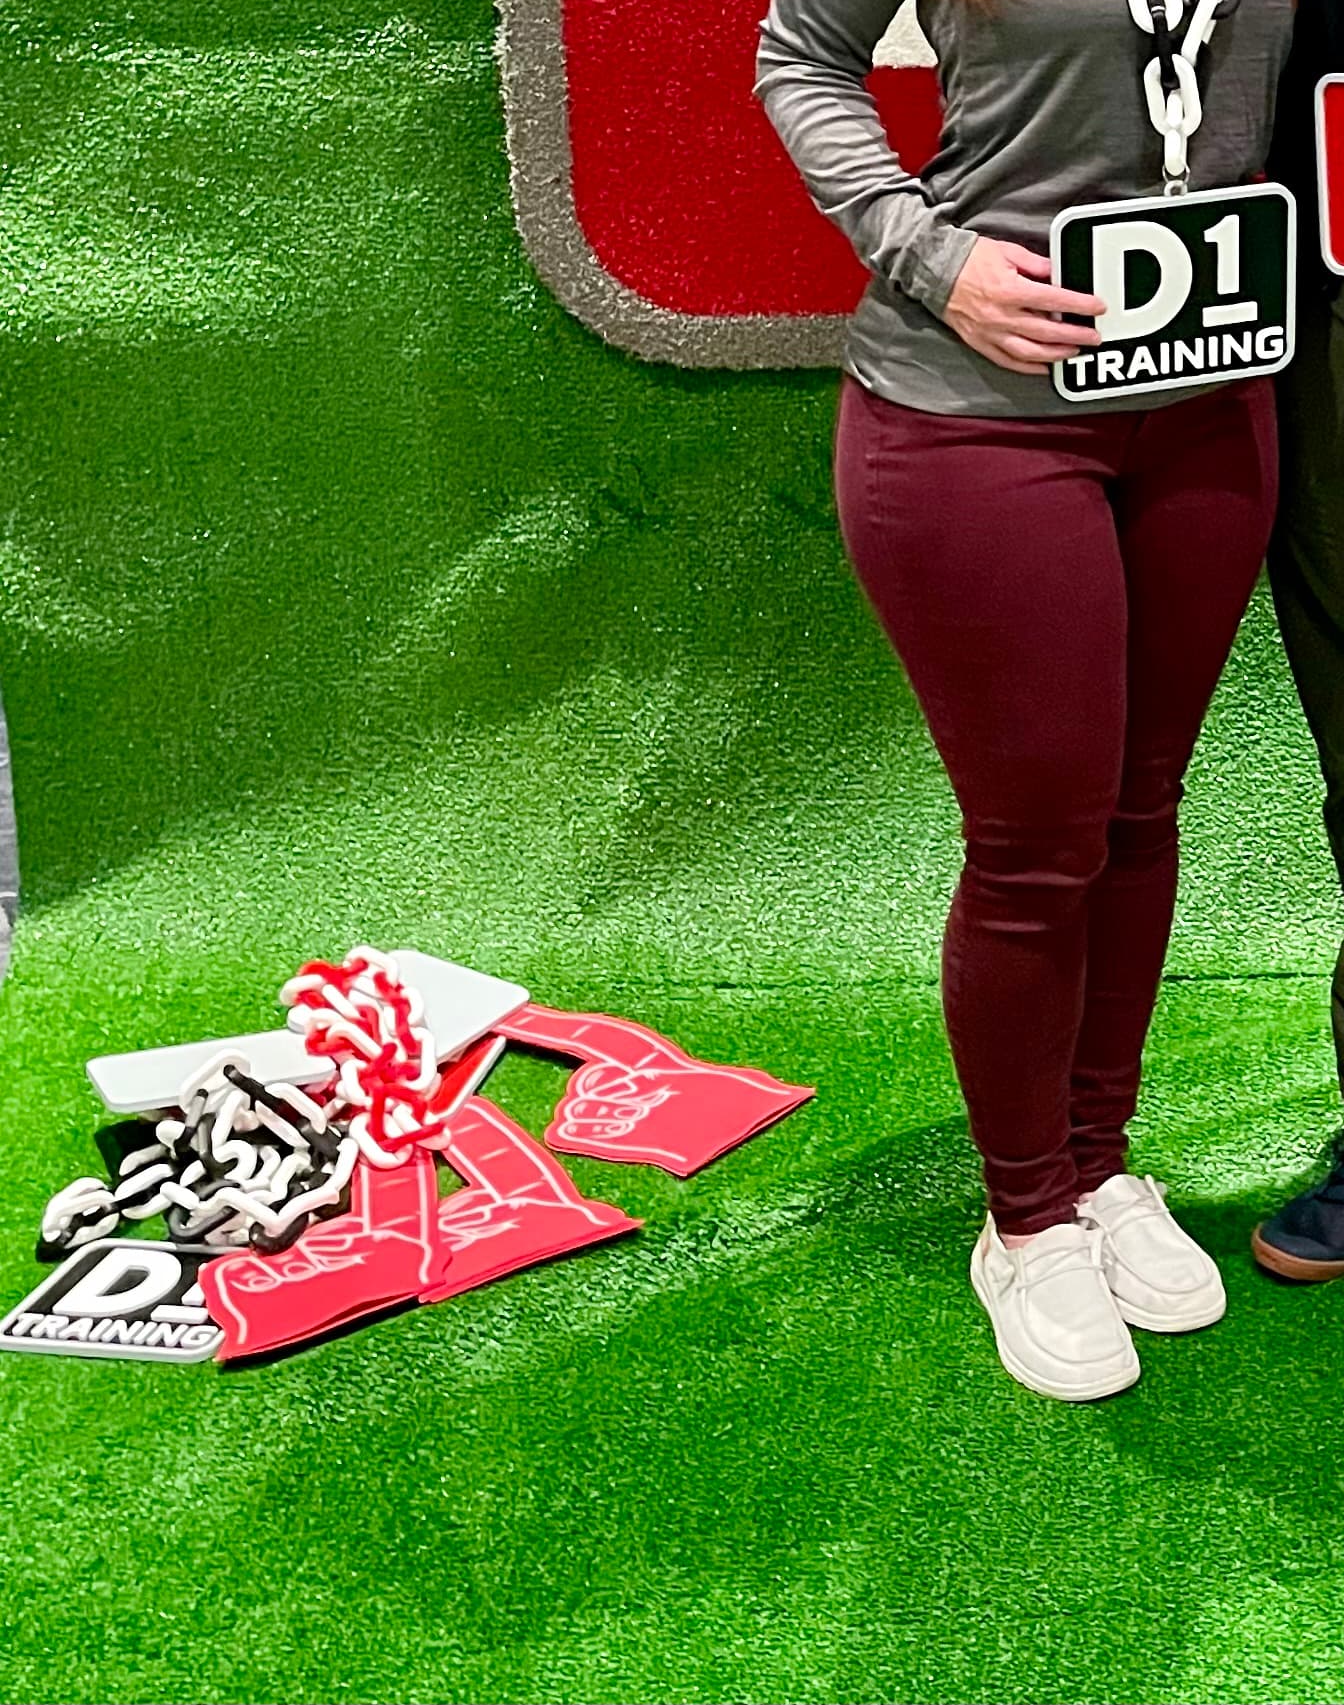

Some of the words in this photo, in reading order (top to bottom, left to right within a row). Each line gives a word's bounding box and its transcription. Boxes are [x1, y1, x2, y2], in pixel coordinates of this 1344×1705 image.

[1092, 213, 1258, 343] D1
[1067, 325, 1285, 387] TRAINING
[52, 1247, 208, 1324] D
[12, 1312, 220, 1347] TRAINING
